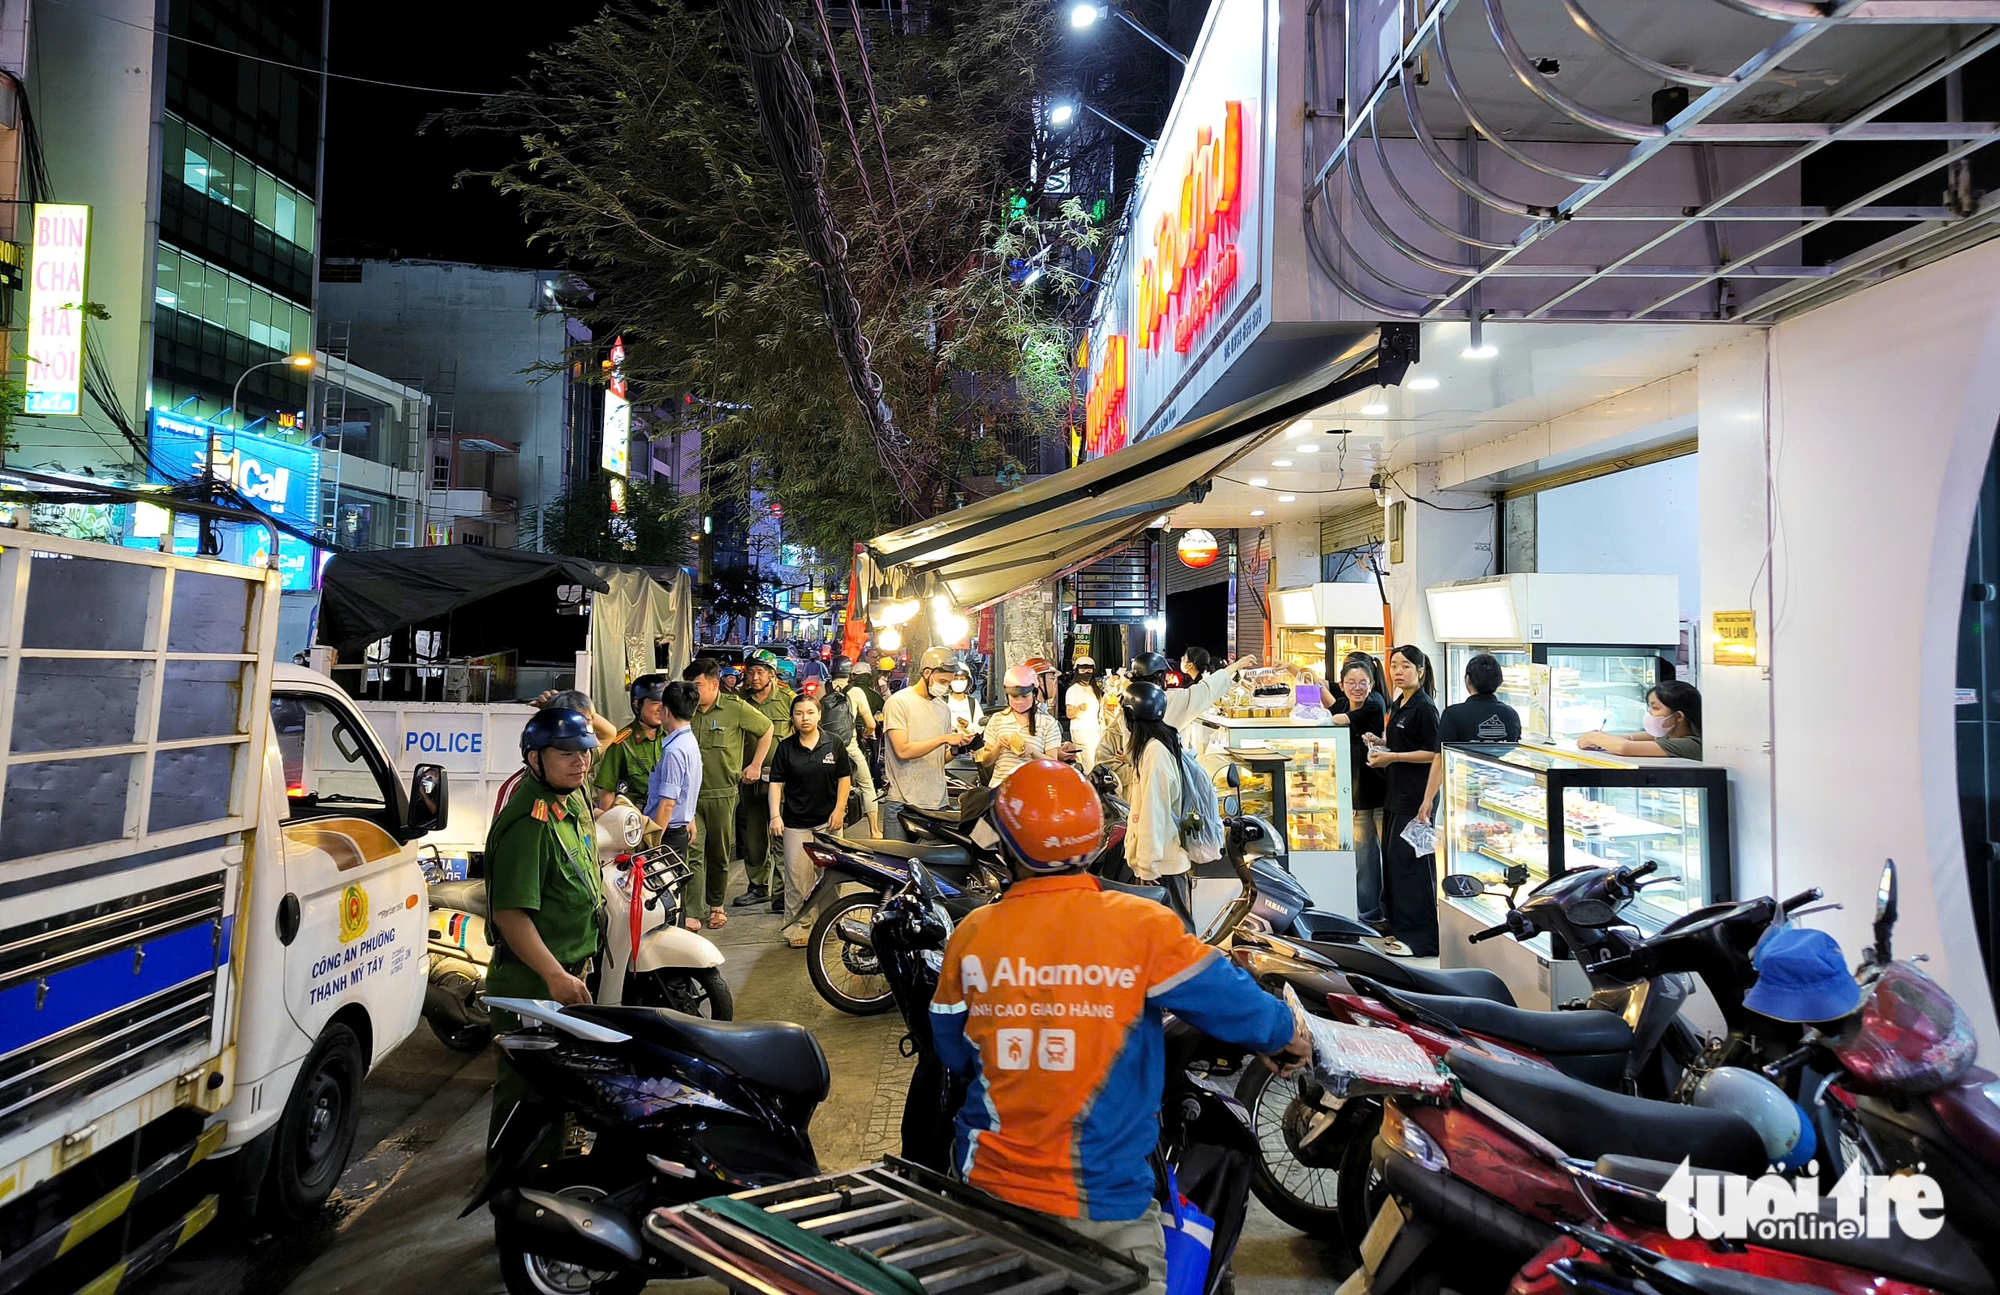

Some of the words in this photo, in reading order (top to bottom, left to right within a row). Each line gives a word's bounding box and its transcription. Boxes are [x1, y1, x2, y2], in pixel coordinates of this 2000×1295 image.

[405, 731, 483, 753] POLICE
[1264, 898, 1288, 916] YAMAHA
[312, 955, 341, 979] CÔNG
[344, 945, 358, 965] AN
[360, 927, 395, 957] PHƯỜNG
[309, 974, 347, 1005] THẠNH
[350, 962, 364, 986] MỸ
[367, 955, 385, 977] TÂY
[992, 957, 1136, 989] Ahamove
[995, 1003, 1027, 1018] CAO
[1030, 1002, 1067, 1017] GIAO
[1069, 1001, 1114, 1019] HÀNG
